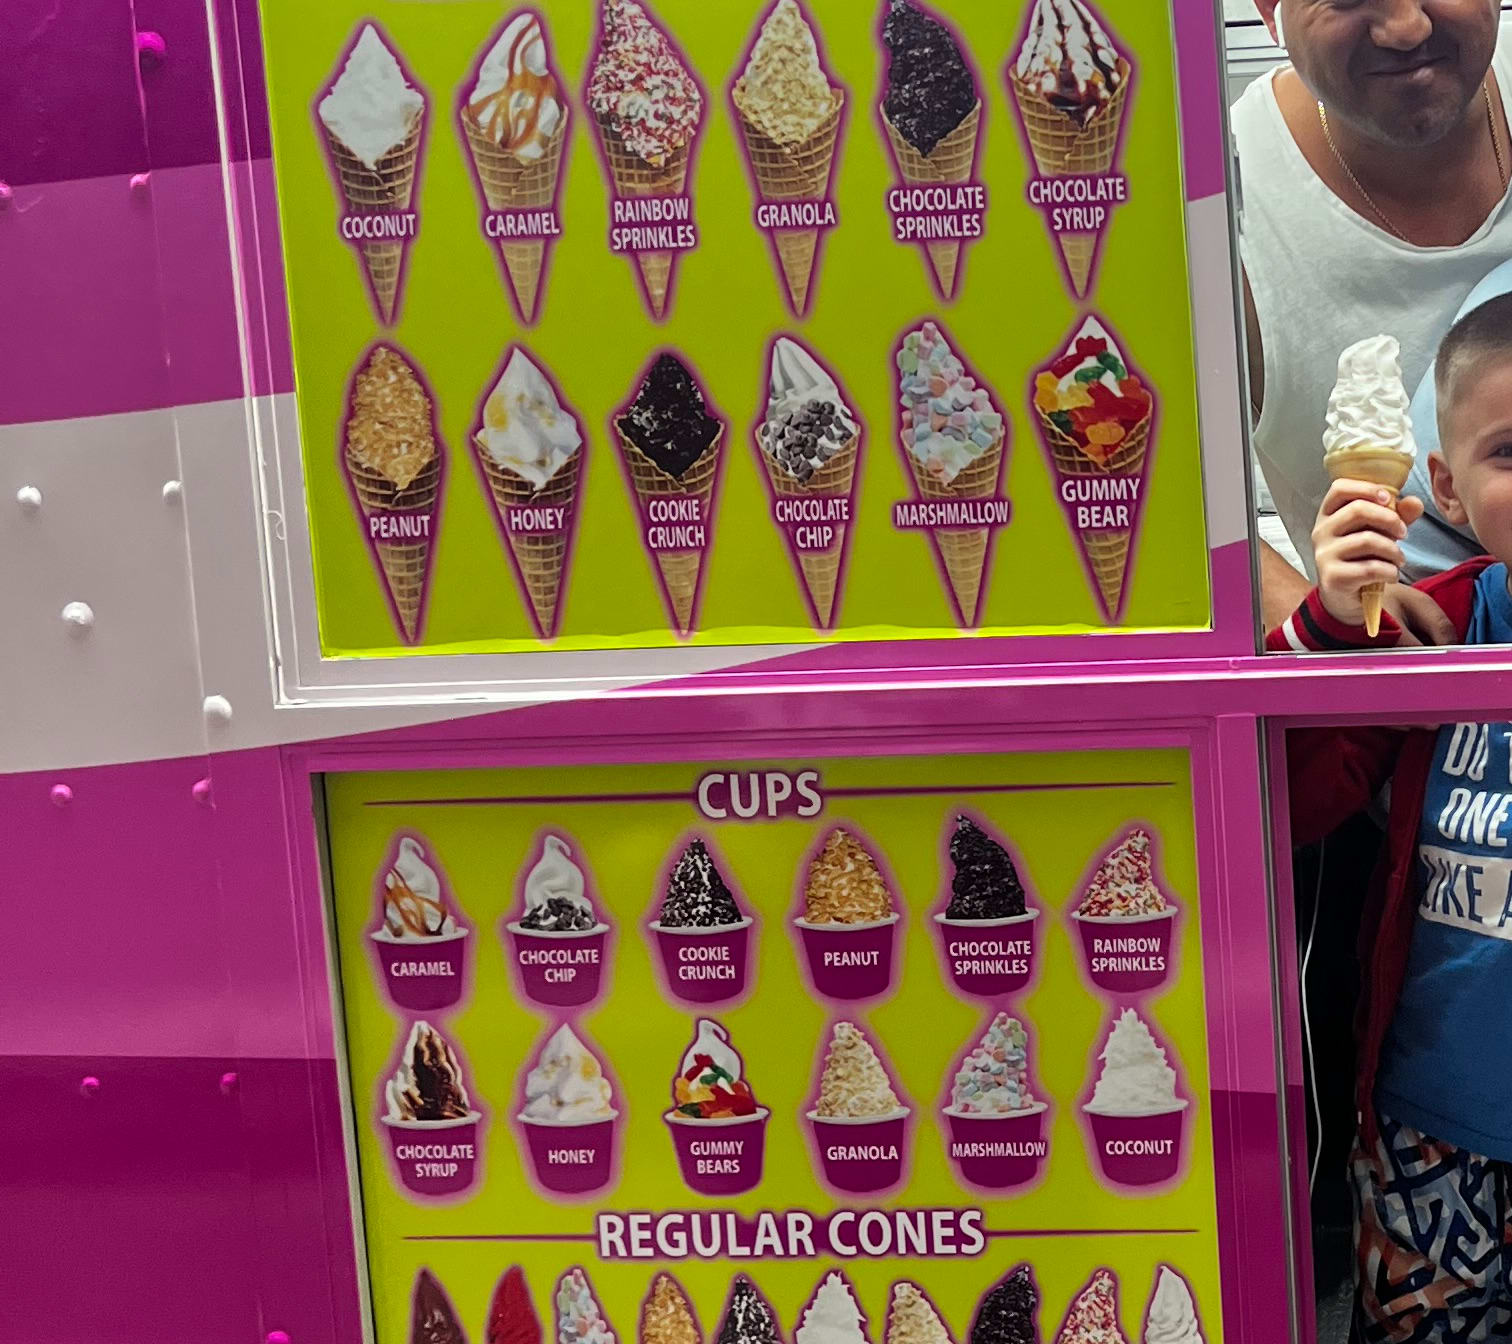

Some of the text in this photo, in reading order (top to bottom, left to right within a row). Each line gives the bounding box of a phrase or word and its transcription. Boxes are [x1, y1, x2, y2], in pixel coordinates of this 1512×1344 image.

[889, 186, 985, 212] CHOCOLATE
[1029, 177, 1125, 203] CHOCOLATE
[614, 198, 689, 223] RAINBOW
[757, 203, 836, 227] GRANOLA
[1053, 206, 1105, 231] SYRUP
[342, 214, 416, 239] COCONUT
[485, 212, 560, 237] CARAMEL
[896, 214, 981, 239] SPRINKLES
[612, 224, 695, 250] SPRINKLES
[1061, 478, 1140, 503] GUMMY
[510, 508, 565, 531] HONEY
[649, 499, 700, 522] COOKIE
[775, 498, 849, 522] CHOCOLATE
[896, 501, 1009, 527] MARSHMALLOW
[1077, 504, 1129, 528] BEAR
[369, 514, 430, 538] PEANUT
[648, 525, 705, 548] CRUNCH
[796, 525, 833, 549] CHIP
[698, 771, 823, 818] CUPS
[679, 946, 730, 963] COOKIE
[949, 940, 1031, 957] CHOCOLATE
[1093, 937, 1160, 953] RAINBOW
[519, 949, 599, 965] CHOCOLATE
[823, 951, 879, 967] PEANUT
[954, 959, 1028, 975] SPRINKLES
[1091, 955, 1165, 973] SPRINKLES
[391, 961, 455, 977] CARAMEL
[544, 967, 577, 982] CHIP
[678, 964, 736, 980] CRUNCH
[396, 1144, 474, 1160] CHOCOLATE
[548, 1149, 596, 1165] HONEY
[690, 1141, 744, 1156] GUMMY
[827, 1145, 899, 1161] GRANOLA
[951, 1141, 1046, 1158] MARSHMALLOW
[1105, 1139, 1173, 1156] COCONUT
[415, 1162, 459, 1178] SYRUP
[696, 1159, 740, 1174] BEARS
[599, 1210, 985, 1257] REGULAR CONES
